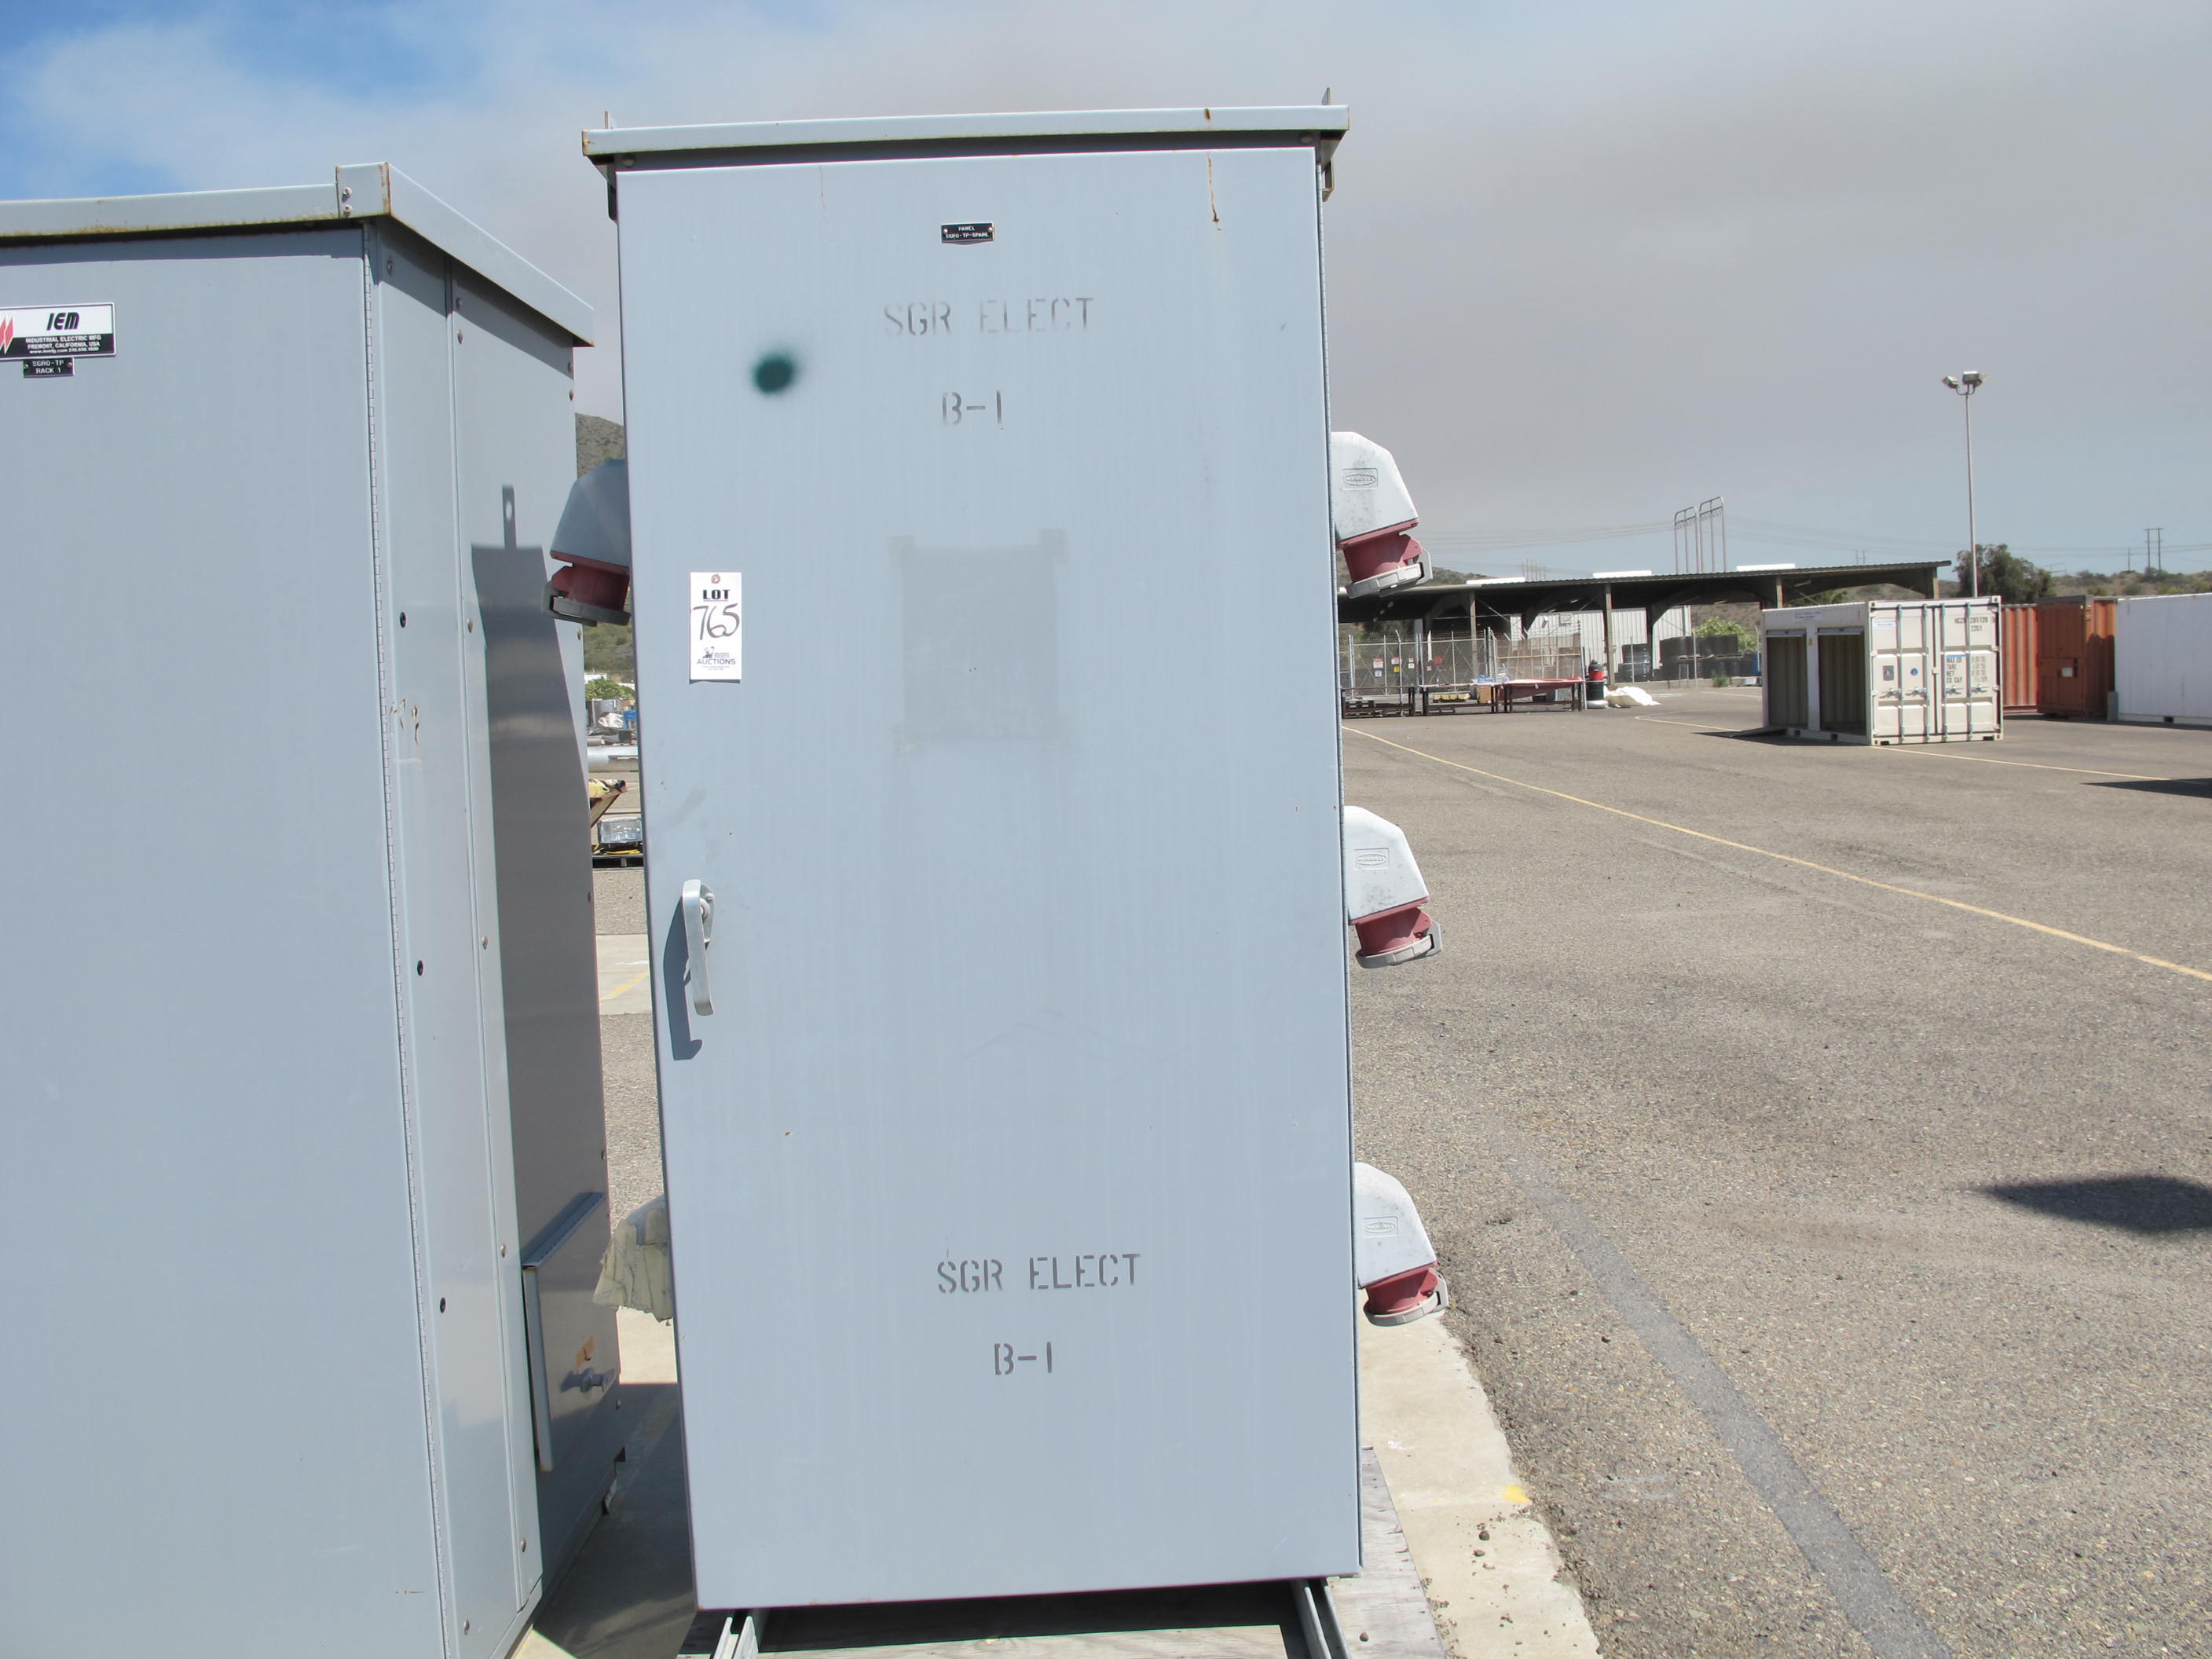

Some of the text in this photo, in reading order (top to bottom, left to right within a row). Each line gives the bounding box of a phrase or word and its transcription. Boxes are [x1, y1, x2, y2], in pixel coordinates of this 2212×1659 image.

[46, 312, 80, 331] IEM
[884, 298, 1093, 335] SGR ELECT
[703, 589, 731, 599] LOT
[693, 603, 740, 640] 765
[937, 1254, 1141, 1293] SGR ELECT
